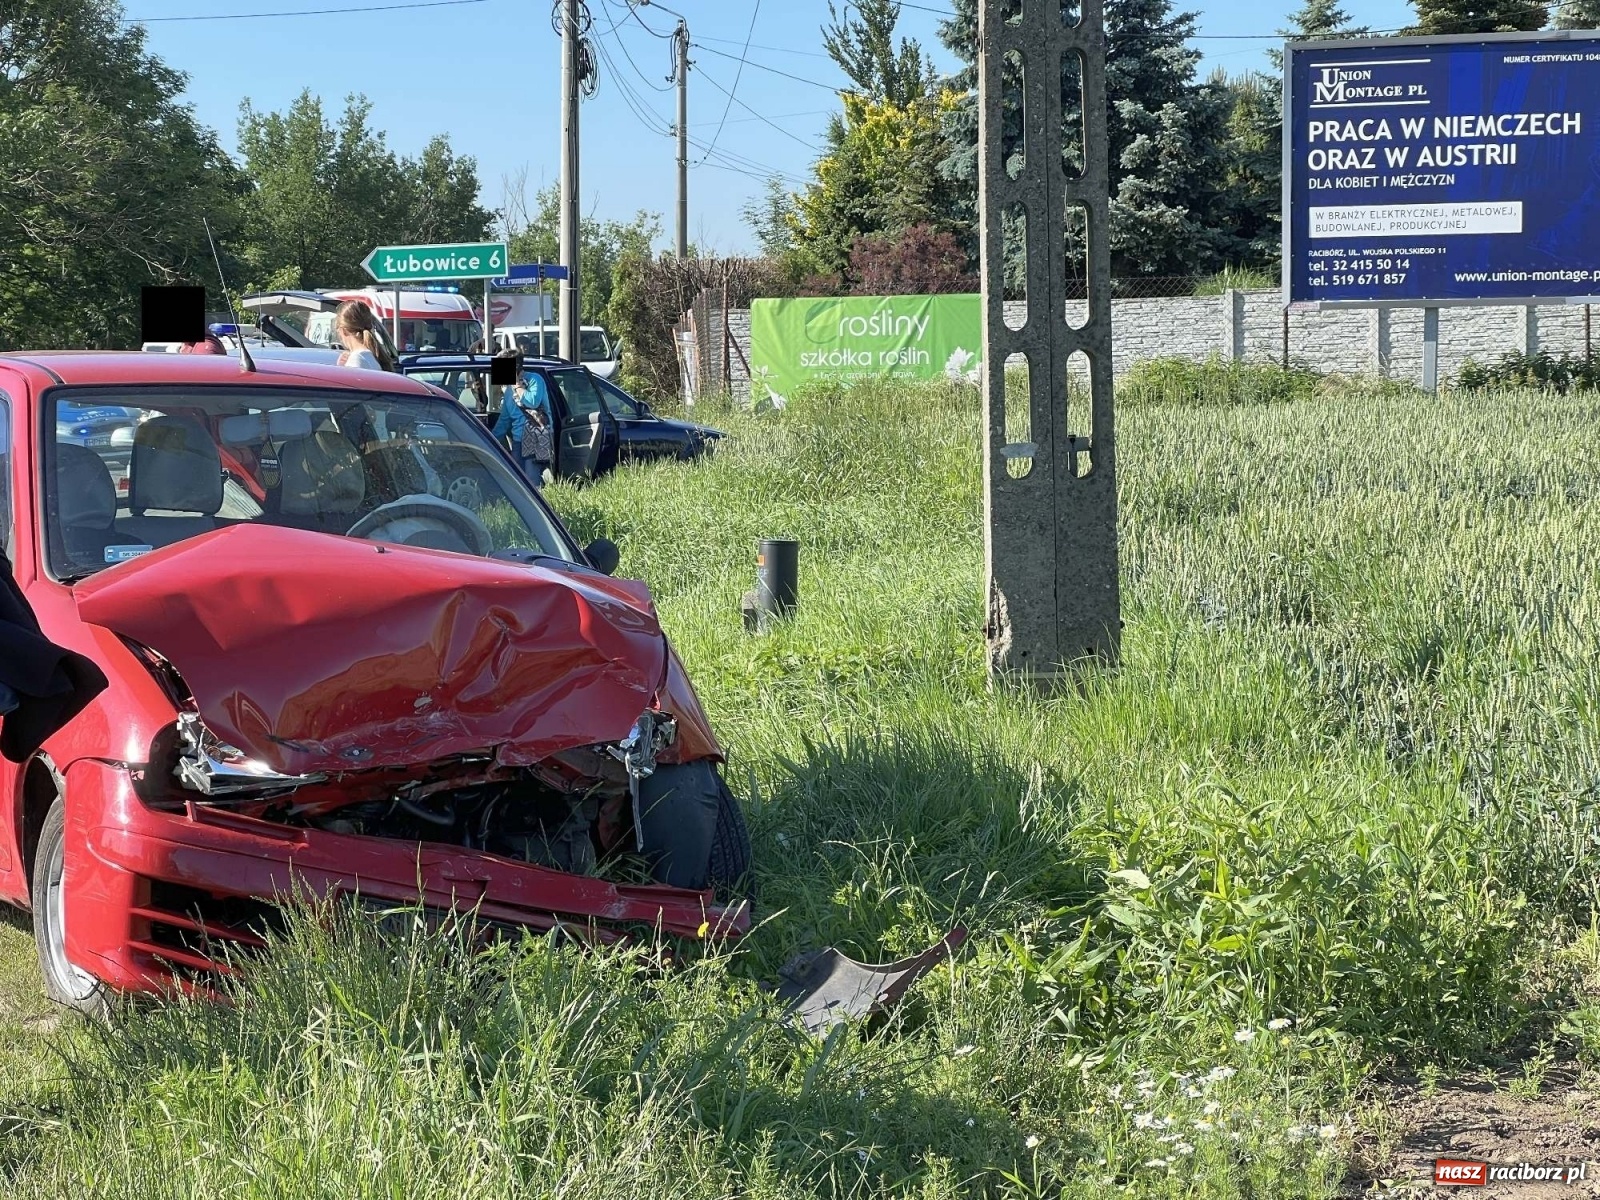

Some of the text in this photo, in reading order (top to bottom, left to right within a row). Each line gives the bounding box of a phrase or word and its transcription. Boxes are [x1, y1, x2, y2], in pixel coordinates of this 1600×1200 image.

[1504, 55, 1530, 63] NUMER
[1532, 54, 1583, 62] CERTYFIKATU
[1408, 84, 1427, 96] PL
[1309, 112, 1581, 143] PRACA W NIEMCZECH
[1308, 143, 1517, 171] ORAZ W AUSTRII
[1309, 172, 1455, 190] DLA KOBIET I MĘŻCZYZN
[1315, 206, 1517, 220] W BRANŻY ELEKTRYCZNEJ, METALOWEJ,
[1315, 221, 1467, 233] BUDOWLANEJ, PRODUKCYJNEJ
[1308, 248, 1347, 258] RACIBÓRZ,
[1348, 248, 1360, 256] UL.
[1362, 248, 1393, 256] WOJSKA
[1394, 247, 1435, 255] POLSKIEGO
[383, 250, 501, 273] Łubowice 6
[1309, 258, 1410, 271] tel. 32 415 50 14
[1309, 273, 1406, 286] tel. 519 671 857
[839, 309, 930, 342] rośliny
[800, 346, 930, 367] szkółka roślin
[892, 370, 916, 379] trawy
